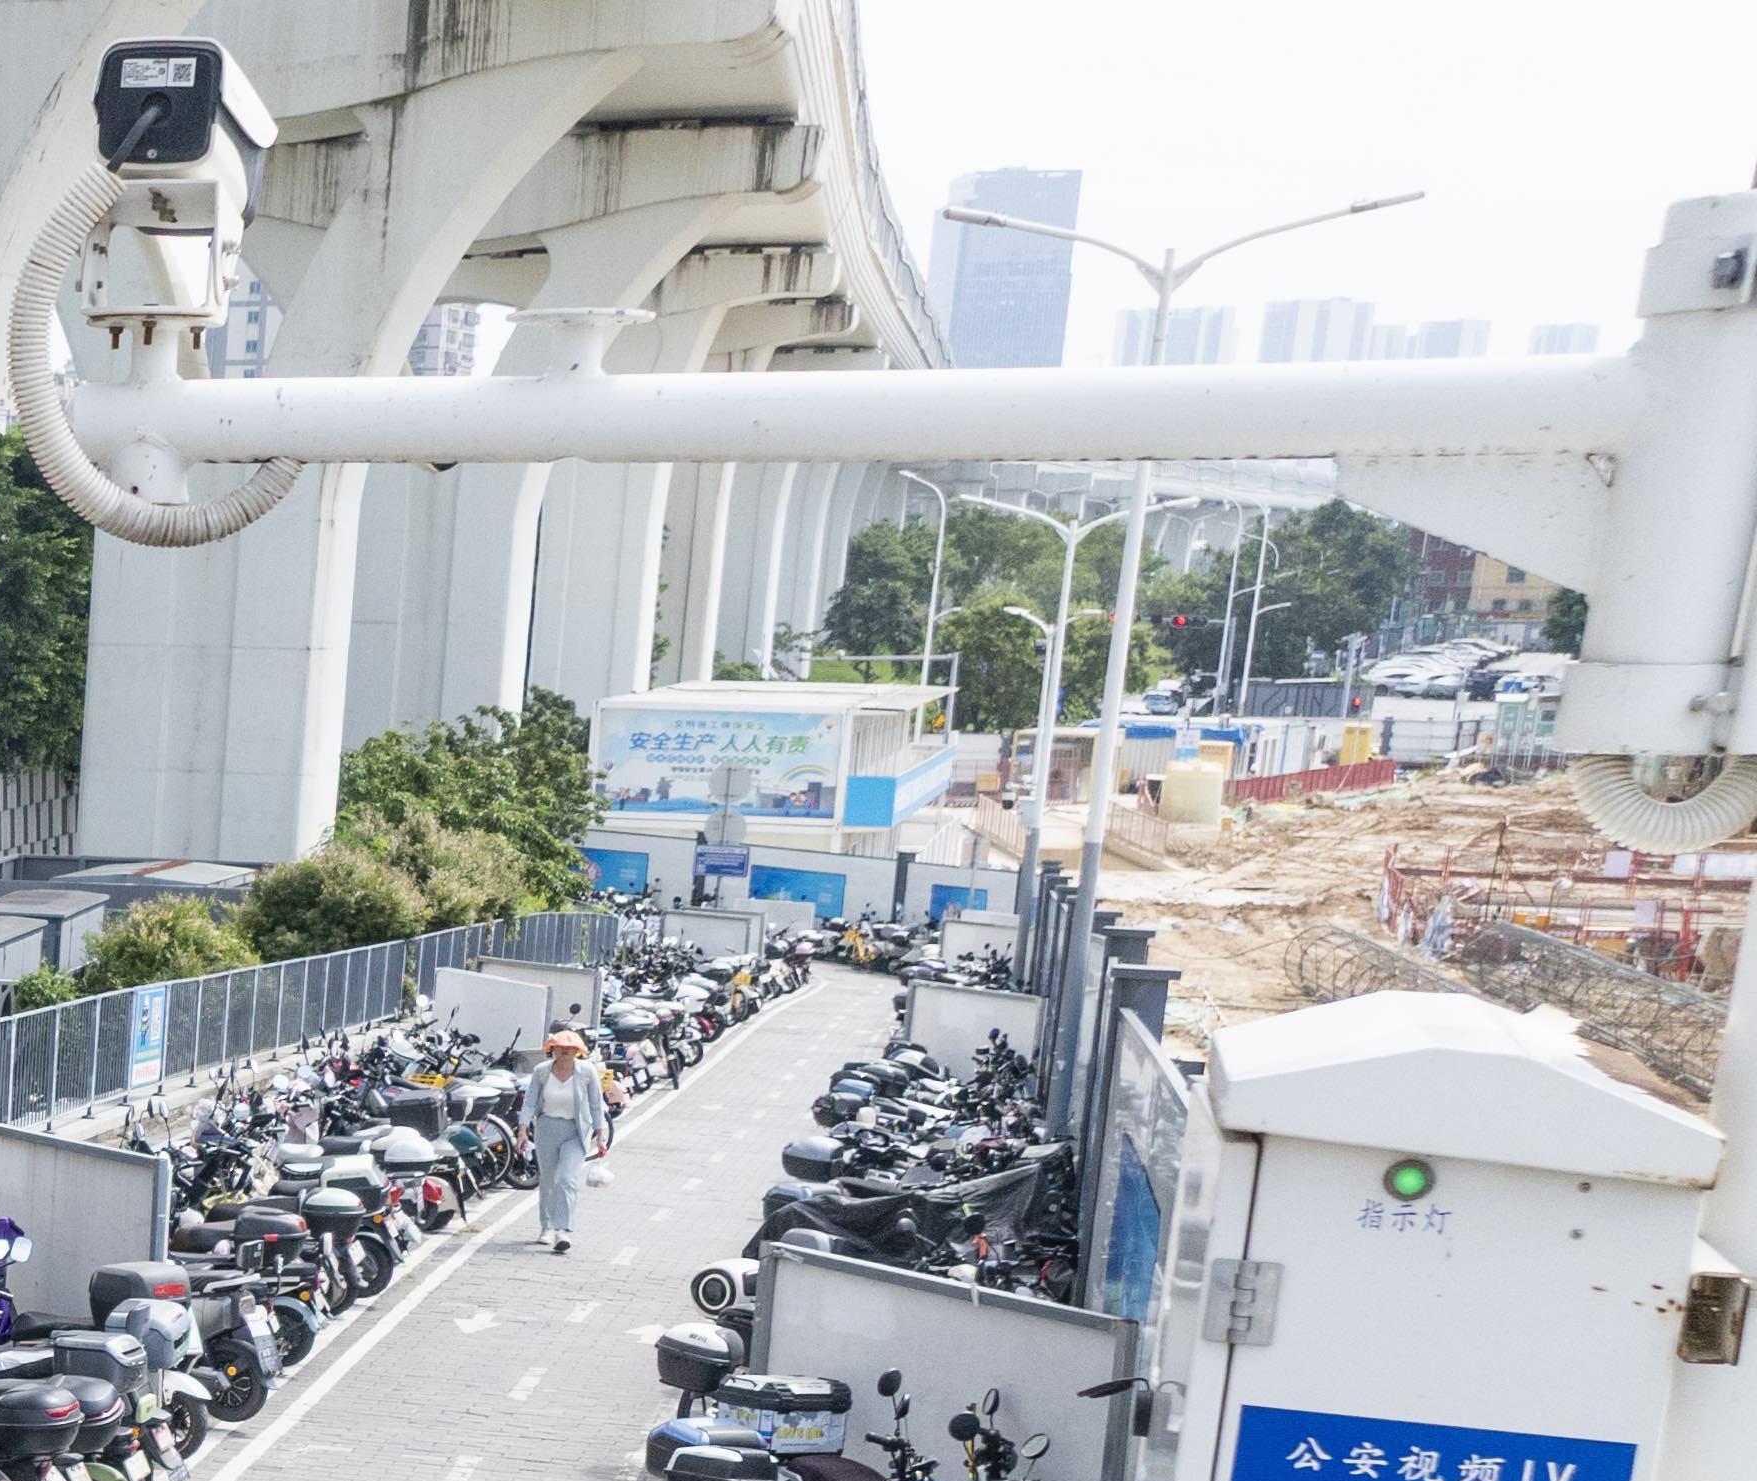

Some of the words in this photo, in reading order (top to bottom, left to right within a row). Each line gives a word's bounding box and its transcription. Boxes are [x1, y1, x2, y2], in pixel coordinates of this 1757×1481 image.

[629, 731, 810, 755] 安全生产人人有责
[1360, 1199, 1453, 1235] 指示灯
